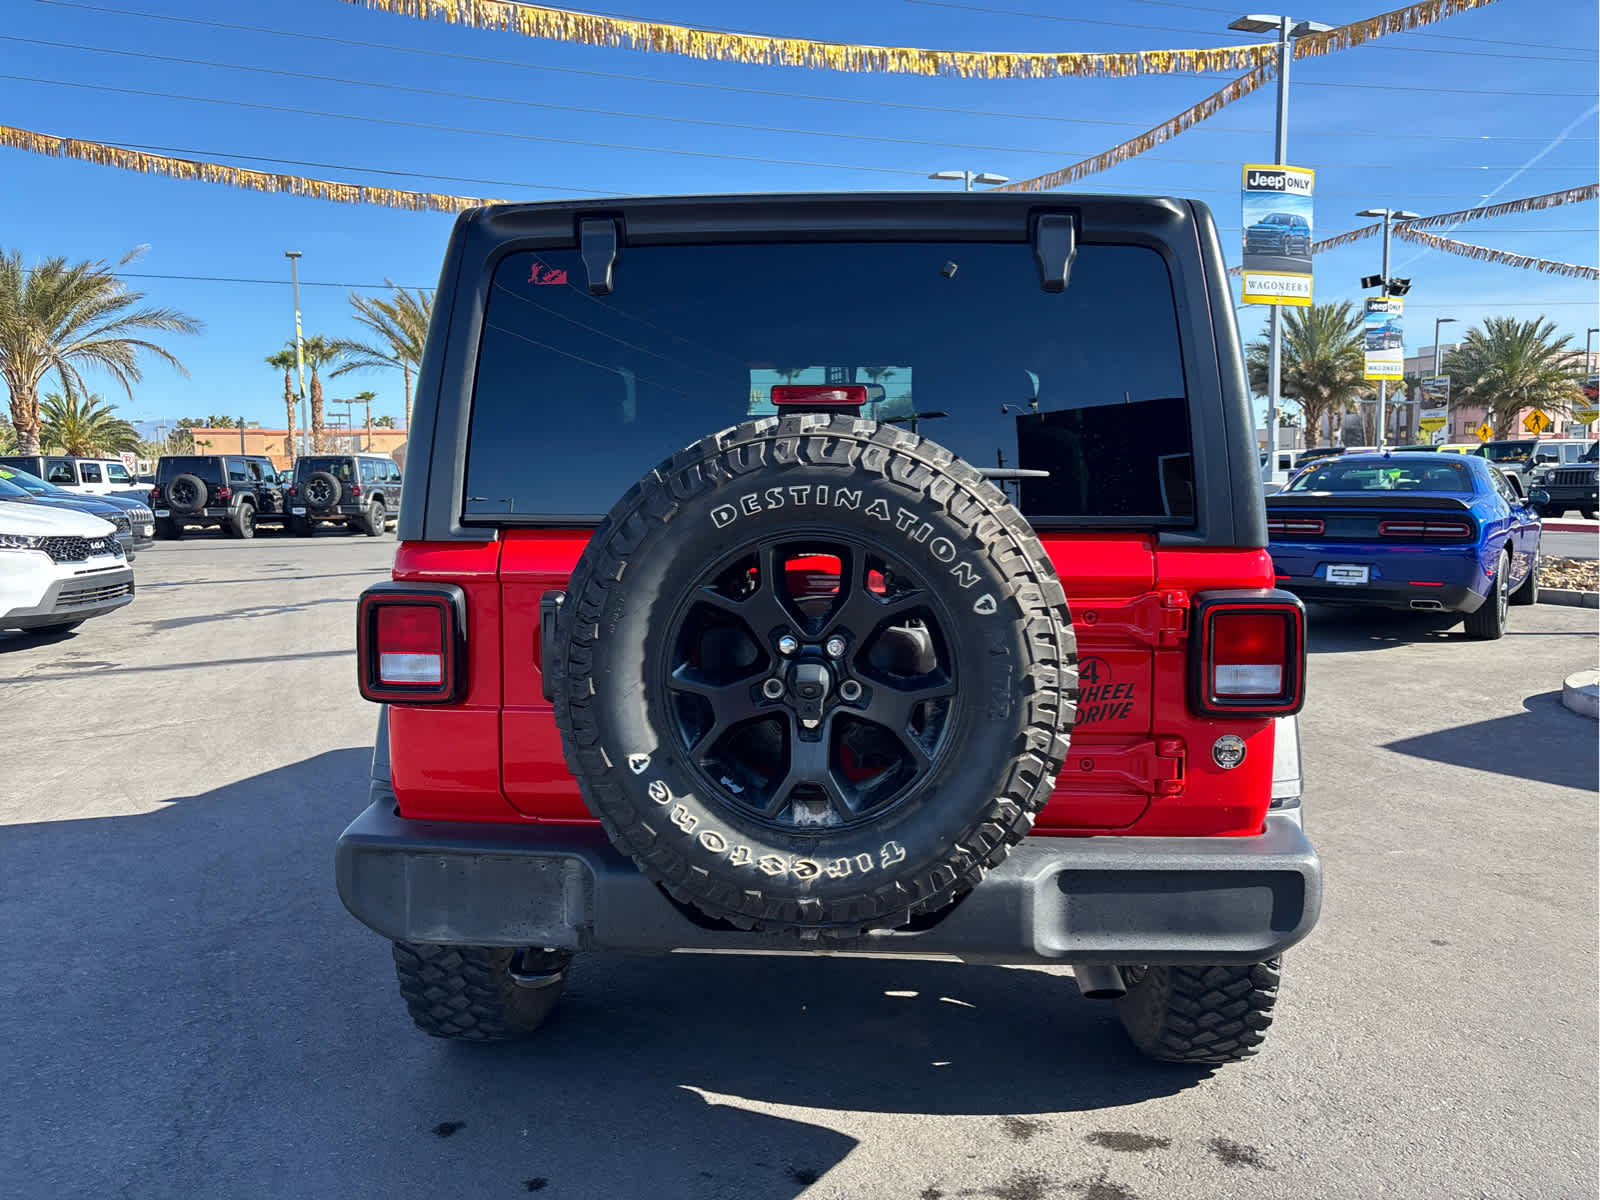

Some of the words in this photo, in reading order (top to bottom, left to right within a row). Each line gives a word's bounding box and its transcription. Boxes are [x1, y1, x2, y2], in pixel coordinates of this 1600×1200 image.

[1249, 172, 1284, 190] Jeep
[1287, 177, 1310, 190] ONLY
[710, 484, 982, 589] DESTINATION
[1079, 660, 1099, 685] 4
[1074, 701, 1134, 726] DRIVE
[648, 779, 906, 880] Firestone
